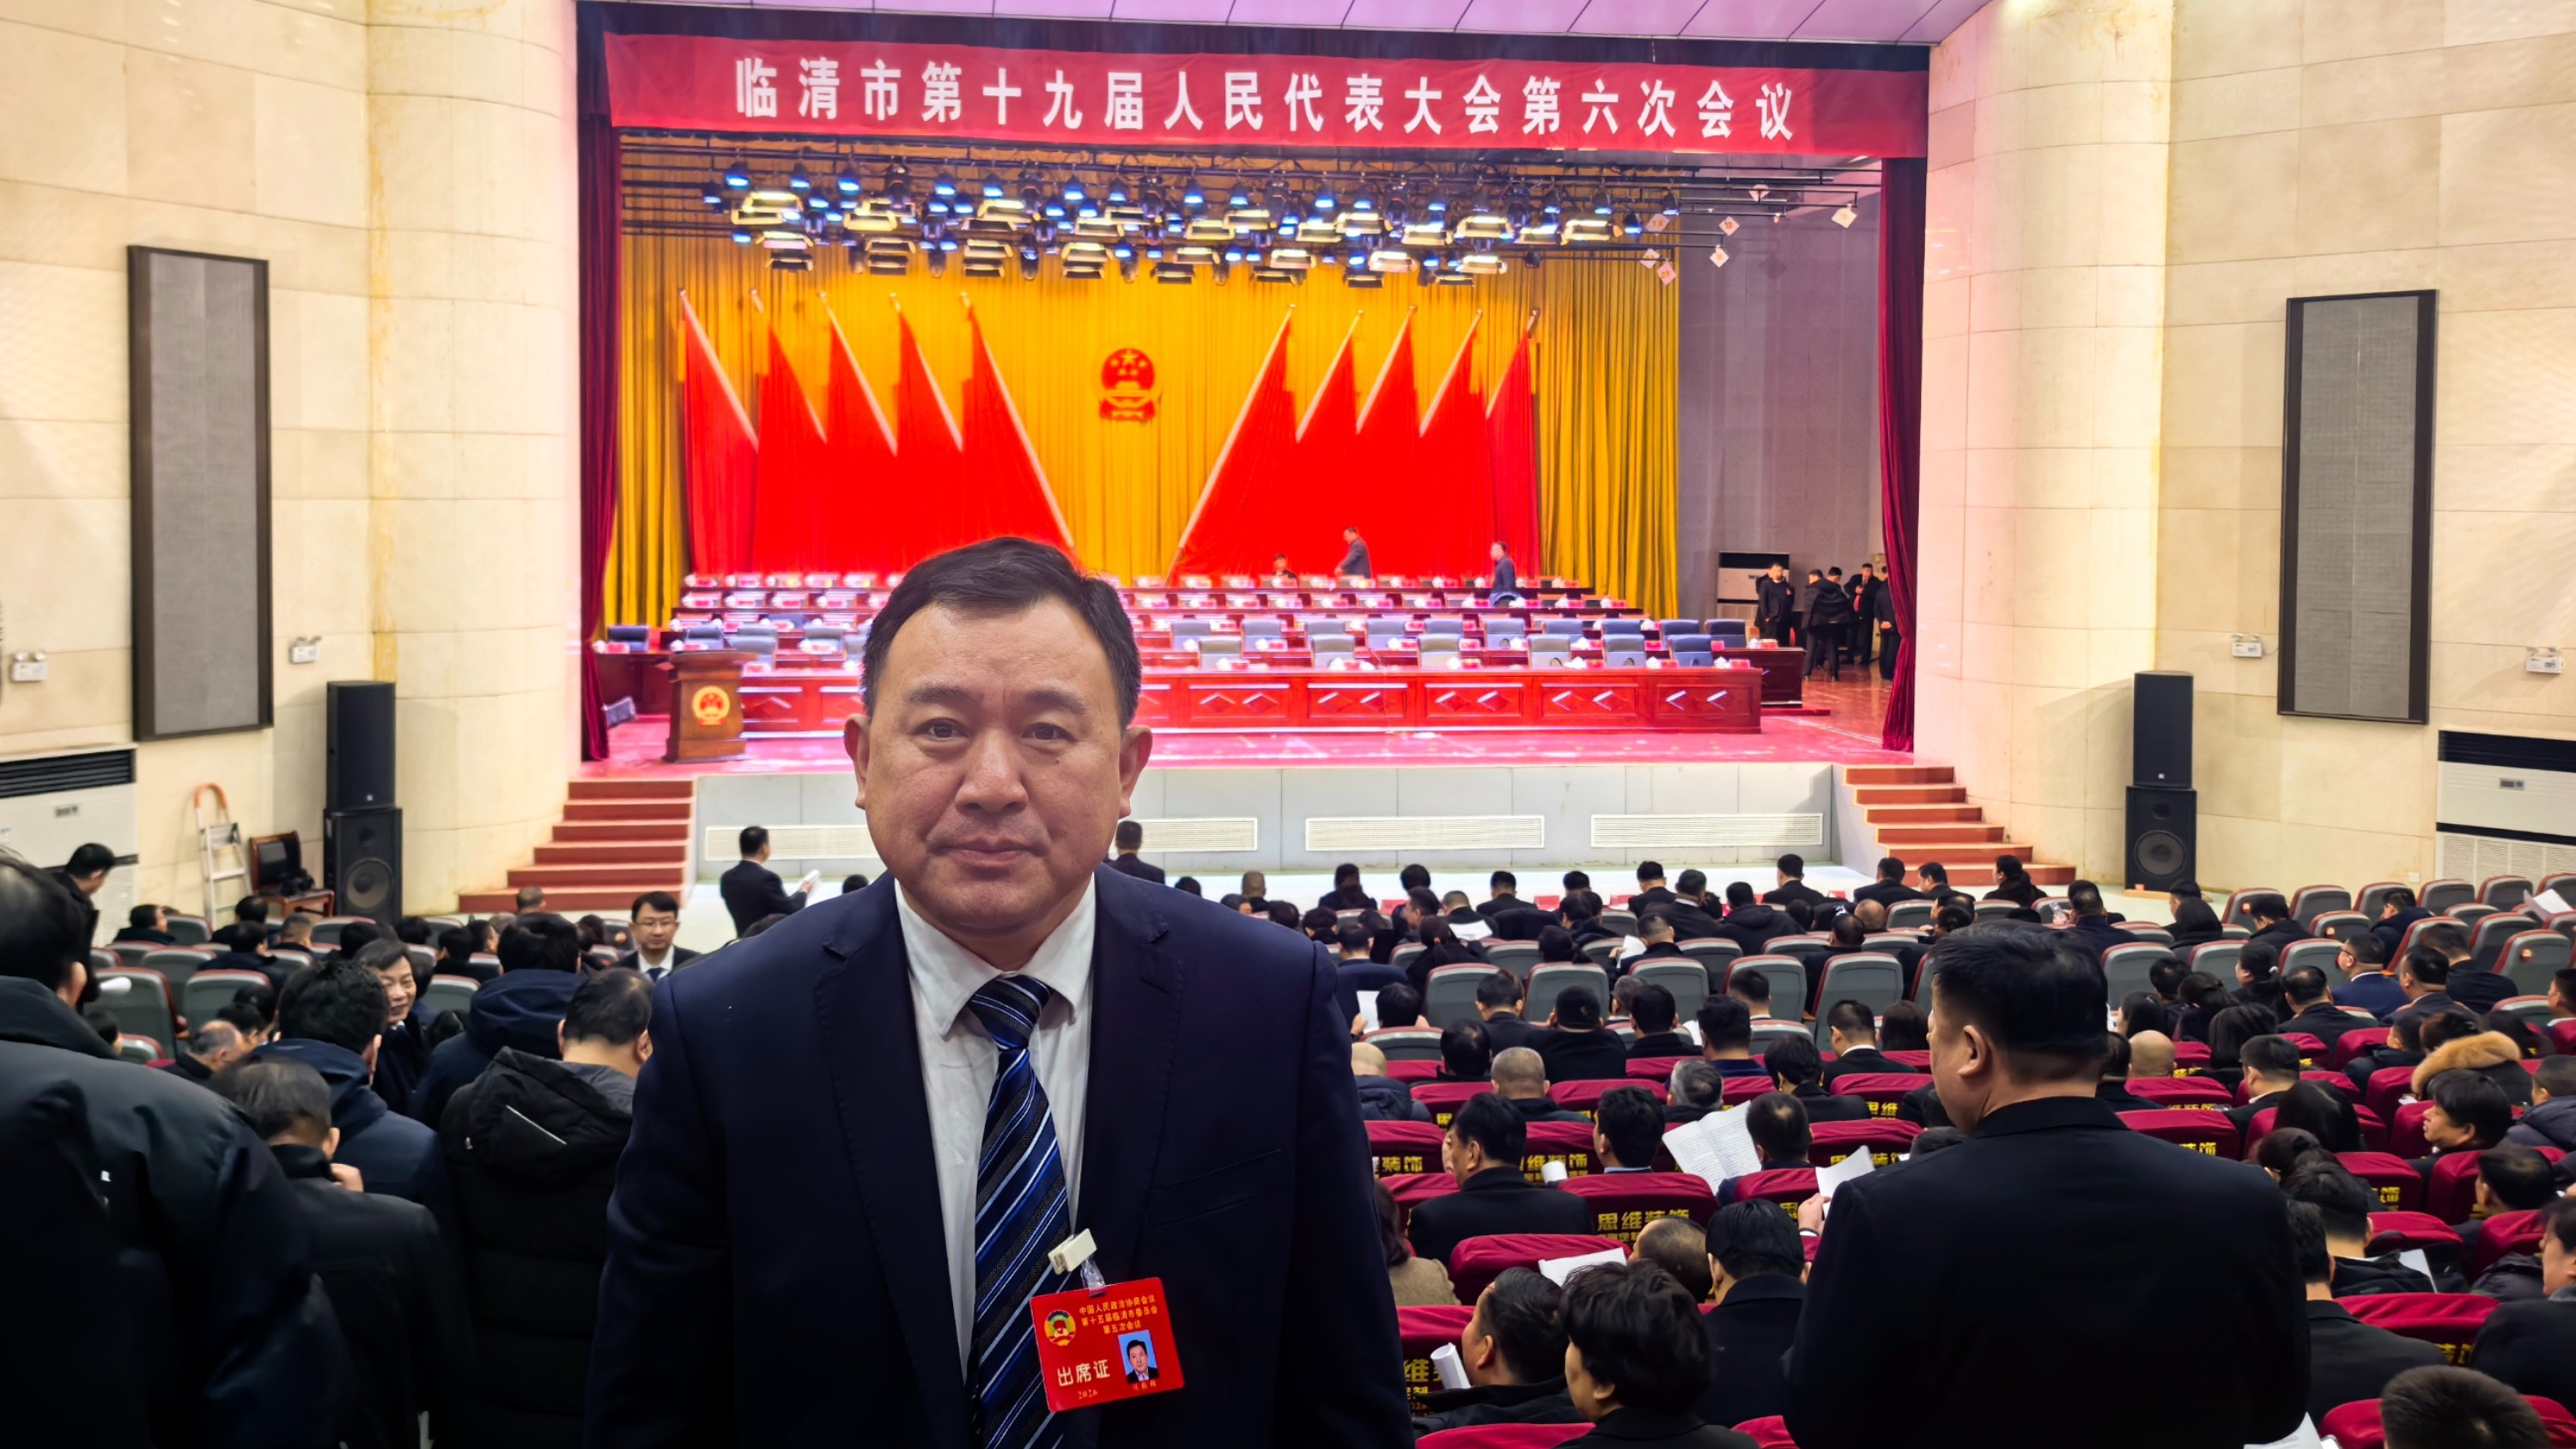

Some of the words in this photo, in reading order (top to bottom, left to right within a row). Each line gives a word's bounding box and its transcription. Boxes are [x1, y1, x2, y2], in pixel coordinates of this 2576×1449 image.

[735, 56, 1793, 141] 临清市第十九届人民代表大会第六次会议
[1078, 1294, 1156, 1315] 中国人民政治协商会议
[1081, 1305, 1157, 1327] 第十五届临清市委员会
[1103, 1319, 1142, 1335] 第五次会议
[1057, 1359, 1111, 1387] 出席证
[1078, 1389, 1098, 1400] 2026
